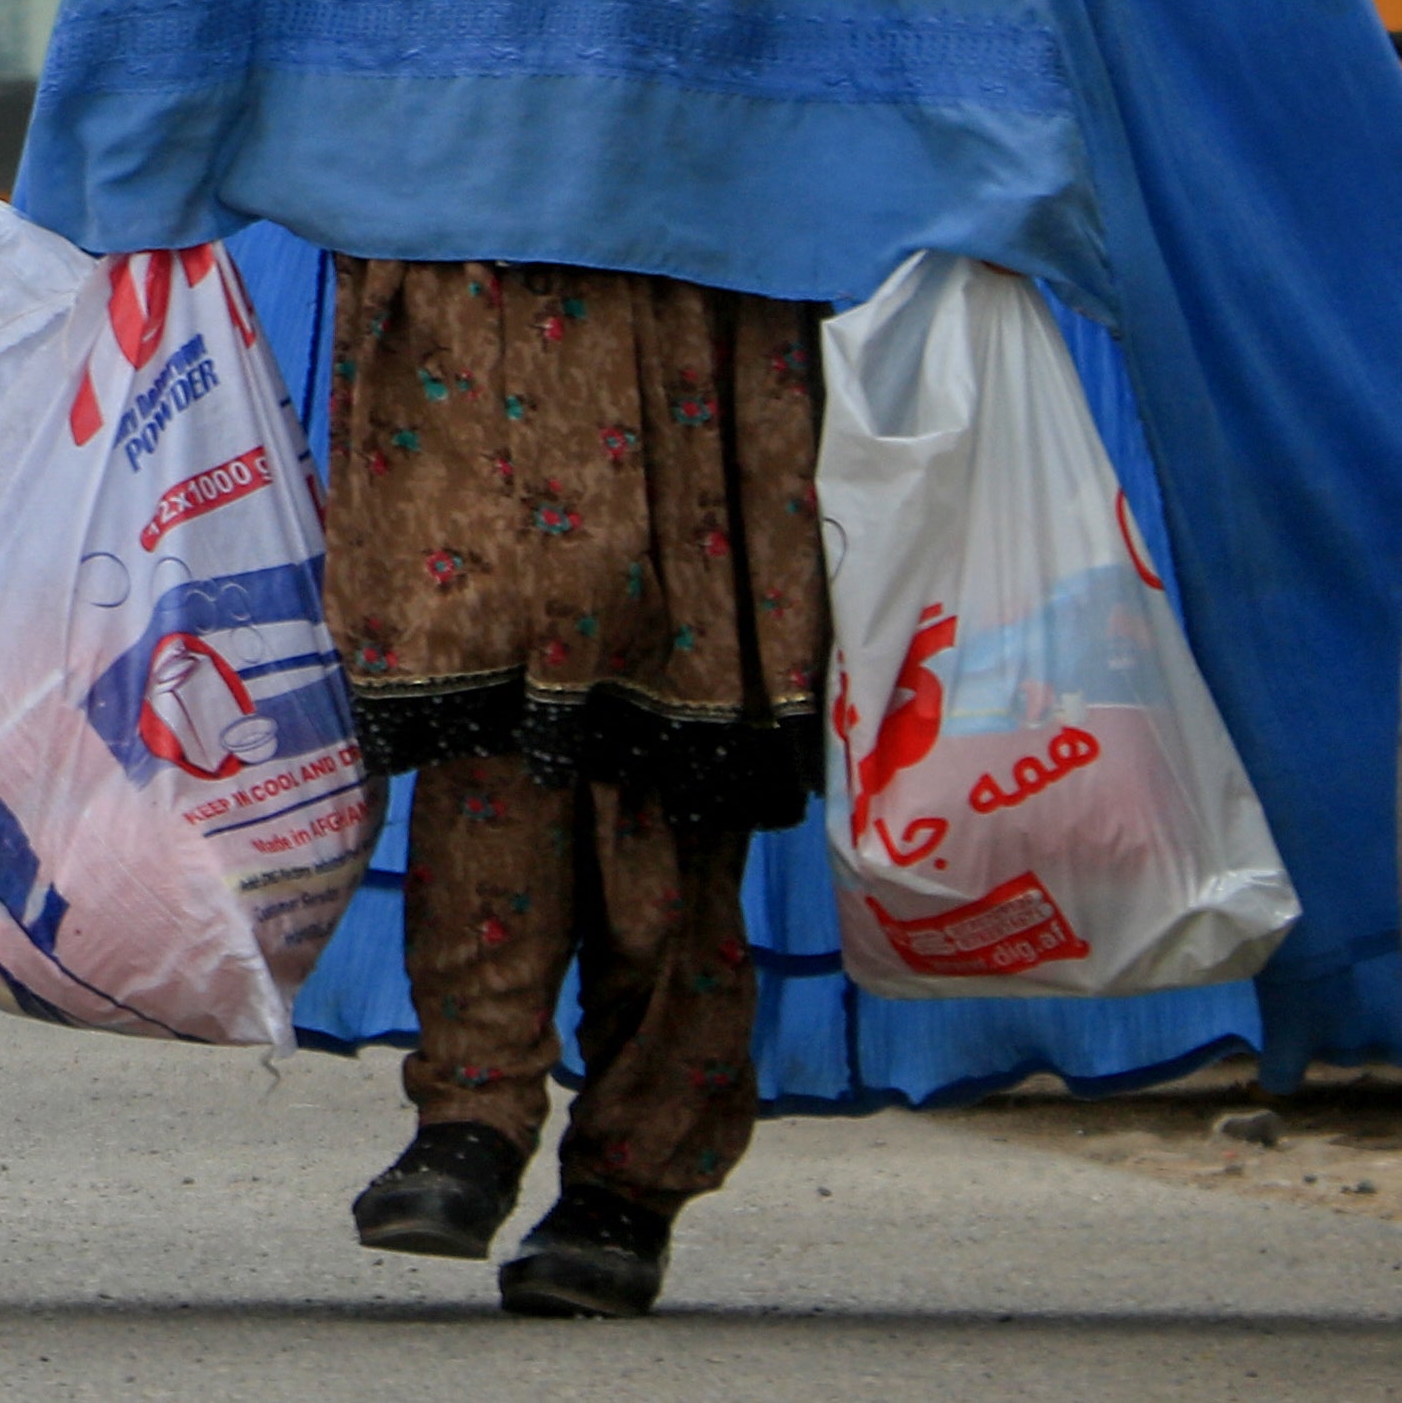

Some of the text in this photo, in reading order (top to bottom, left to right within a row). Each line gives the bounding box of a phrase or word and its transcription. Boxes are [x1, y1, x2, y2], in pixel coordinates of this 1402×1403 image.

[123, 358, 219, 474] POWDER
[182, 797, 231, 826] KEEP
[250, 772, 300, 802] COOL
[300, 755, 338, 783] AND
[874, 725, 1100, 870] همه جا
[292, 829, 311, 846] in
